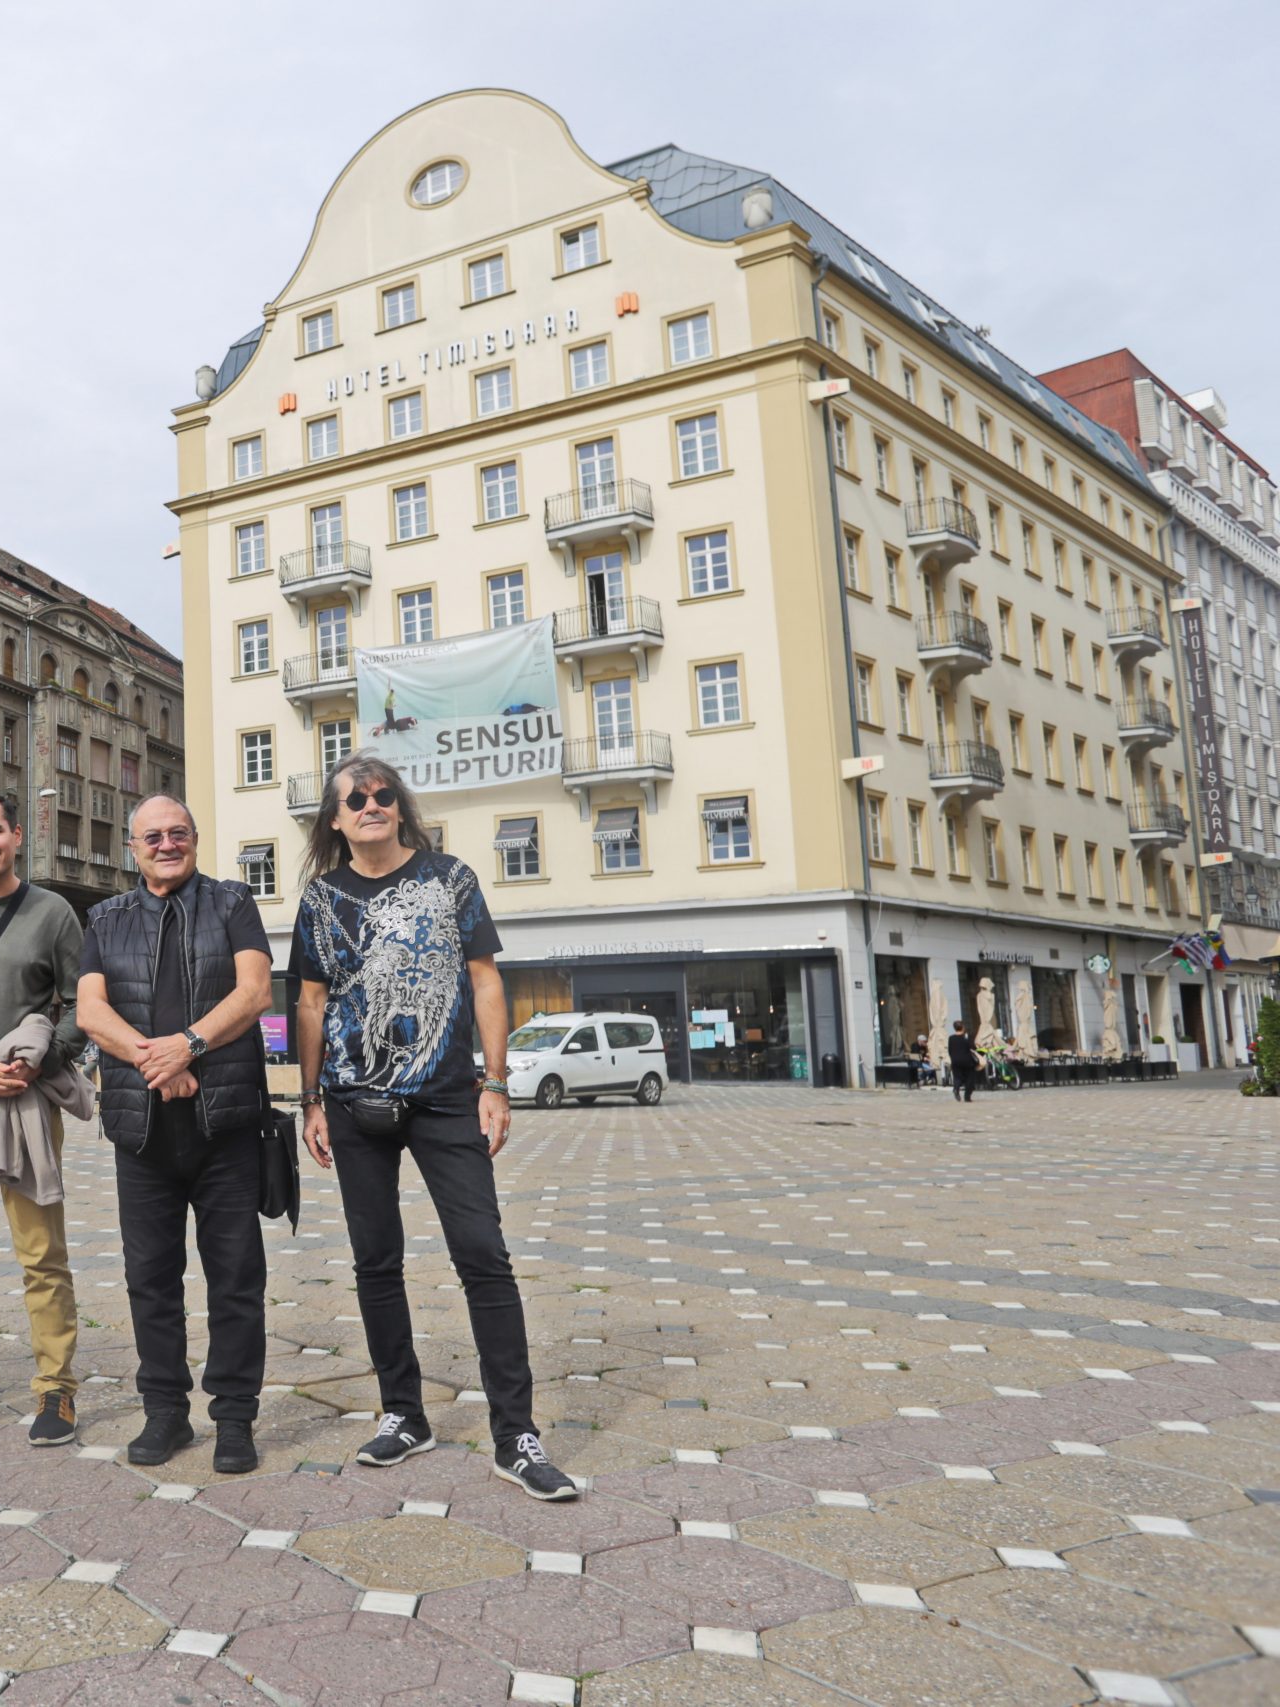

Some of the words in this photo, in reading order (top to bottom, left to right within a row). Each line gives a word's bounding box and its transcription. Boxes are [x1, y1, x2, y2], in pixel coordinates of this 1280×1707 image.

[326, 359, 406, 401] HOTEL
[1188, 618, 1206, 698] HOTEL
[436, 714, 562, 756] SENSUL
[395, 746, 555, 787] ULPTURII
[546, 941, 638, 957] STARBUCKS
[644, 938, 705, 952] COFFEE
